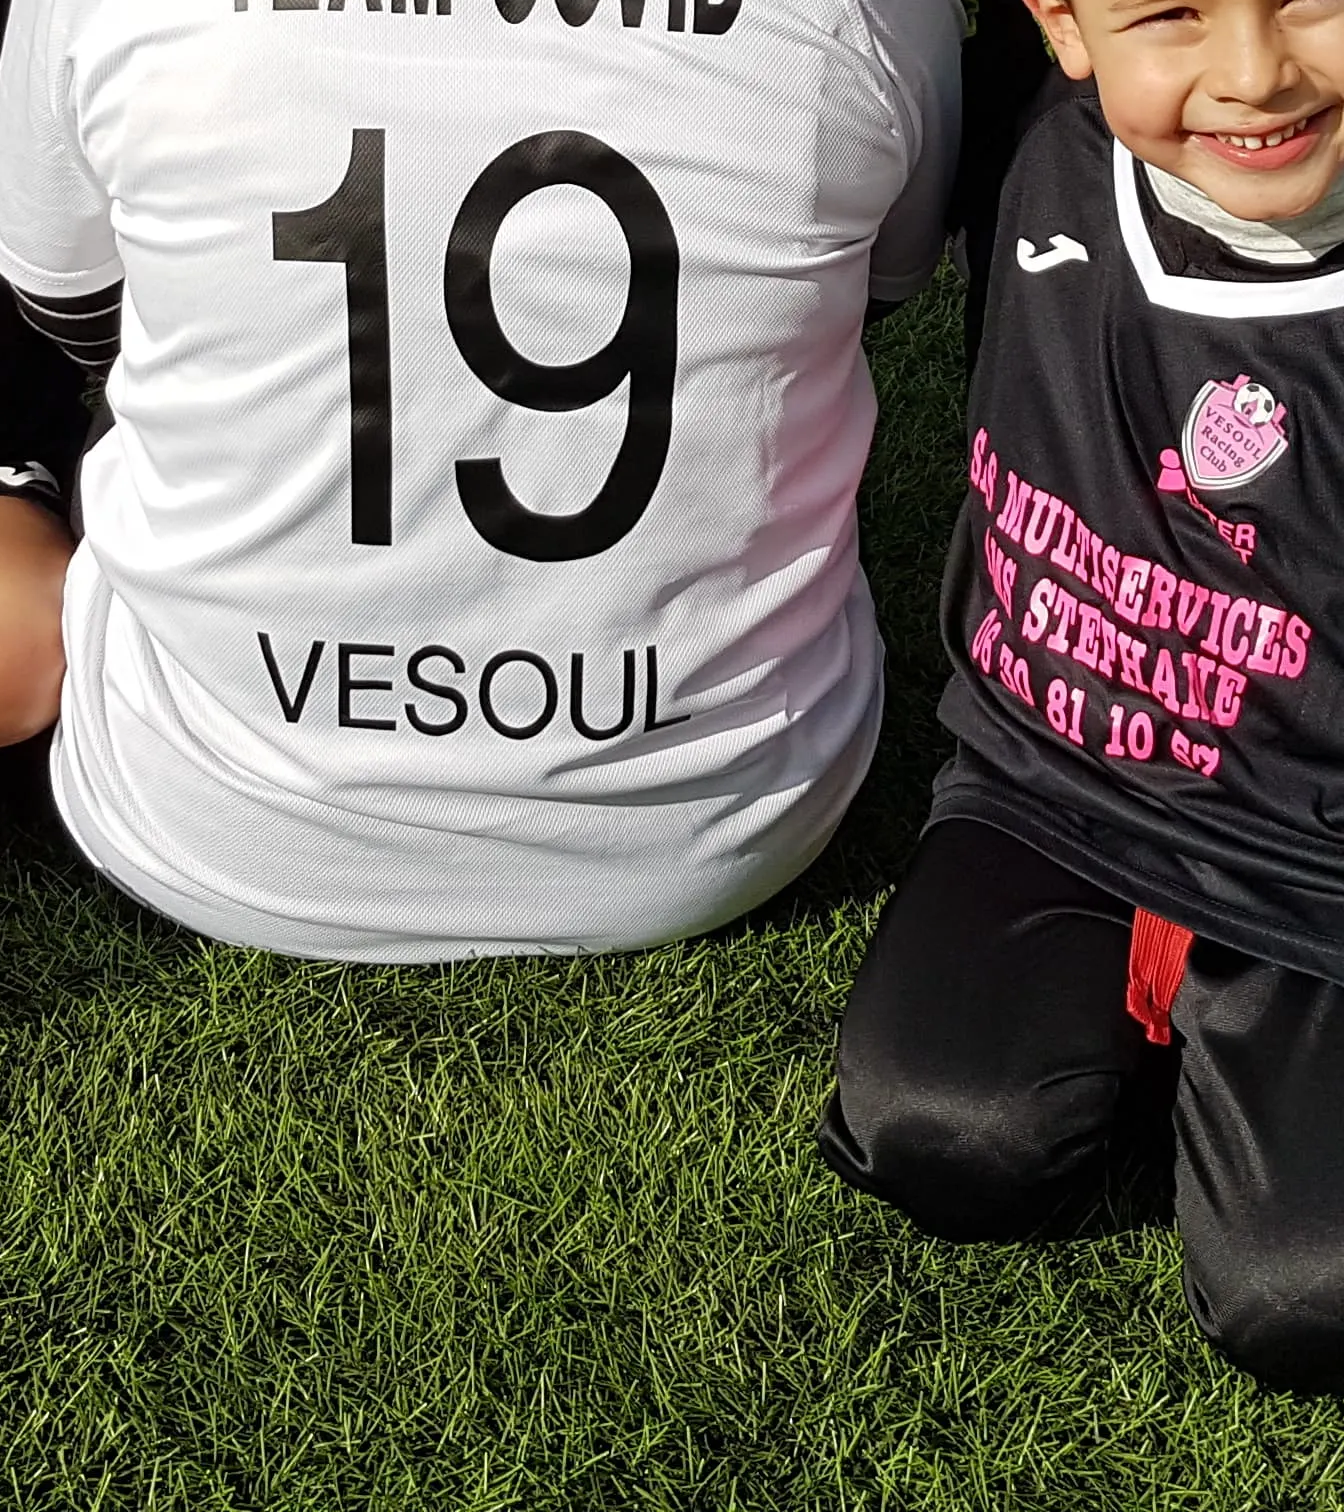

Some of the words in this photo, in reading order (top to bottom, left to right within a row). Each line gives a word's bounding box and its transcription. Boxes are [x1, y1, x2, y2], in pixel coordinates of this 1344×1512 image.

[272, 128, 680, 563] 19
[1200, 445, 1228, 473] Club
[1201, 426, 1245, 468] Racing
[1206, 406, 1263, 461] VESOUL
[996, 469, 1312, 679] MULTISERVICES
[258, 632, 694, 741] VESOUL
[1022, 577, 1248, 728] STEPHANE
[1046, 678, 1085, 746] 81
[1105, 703, 1154, 760] 10
